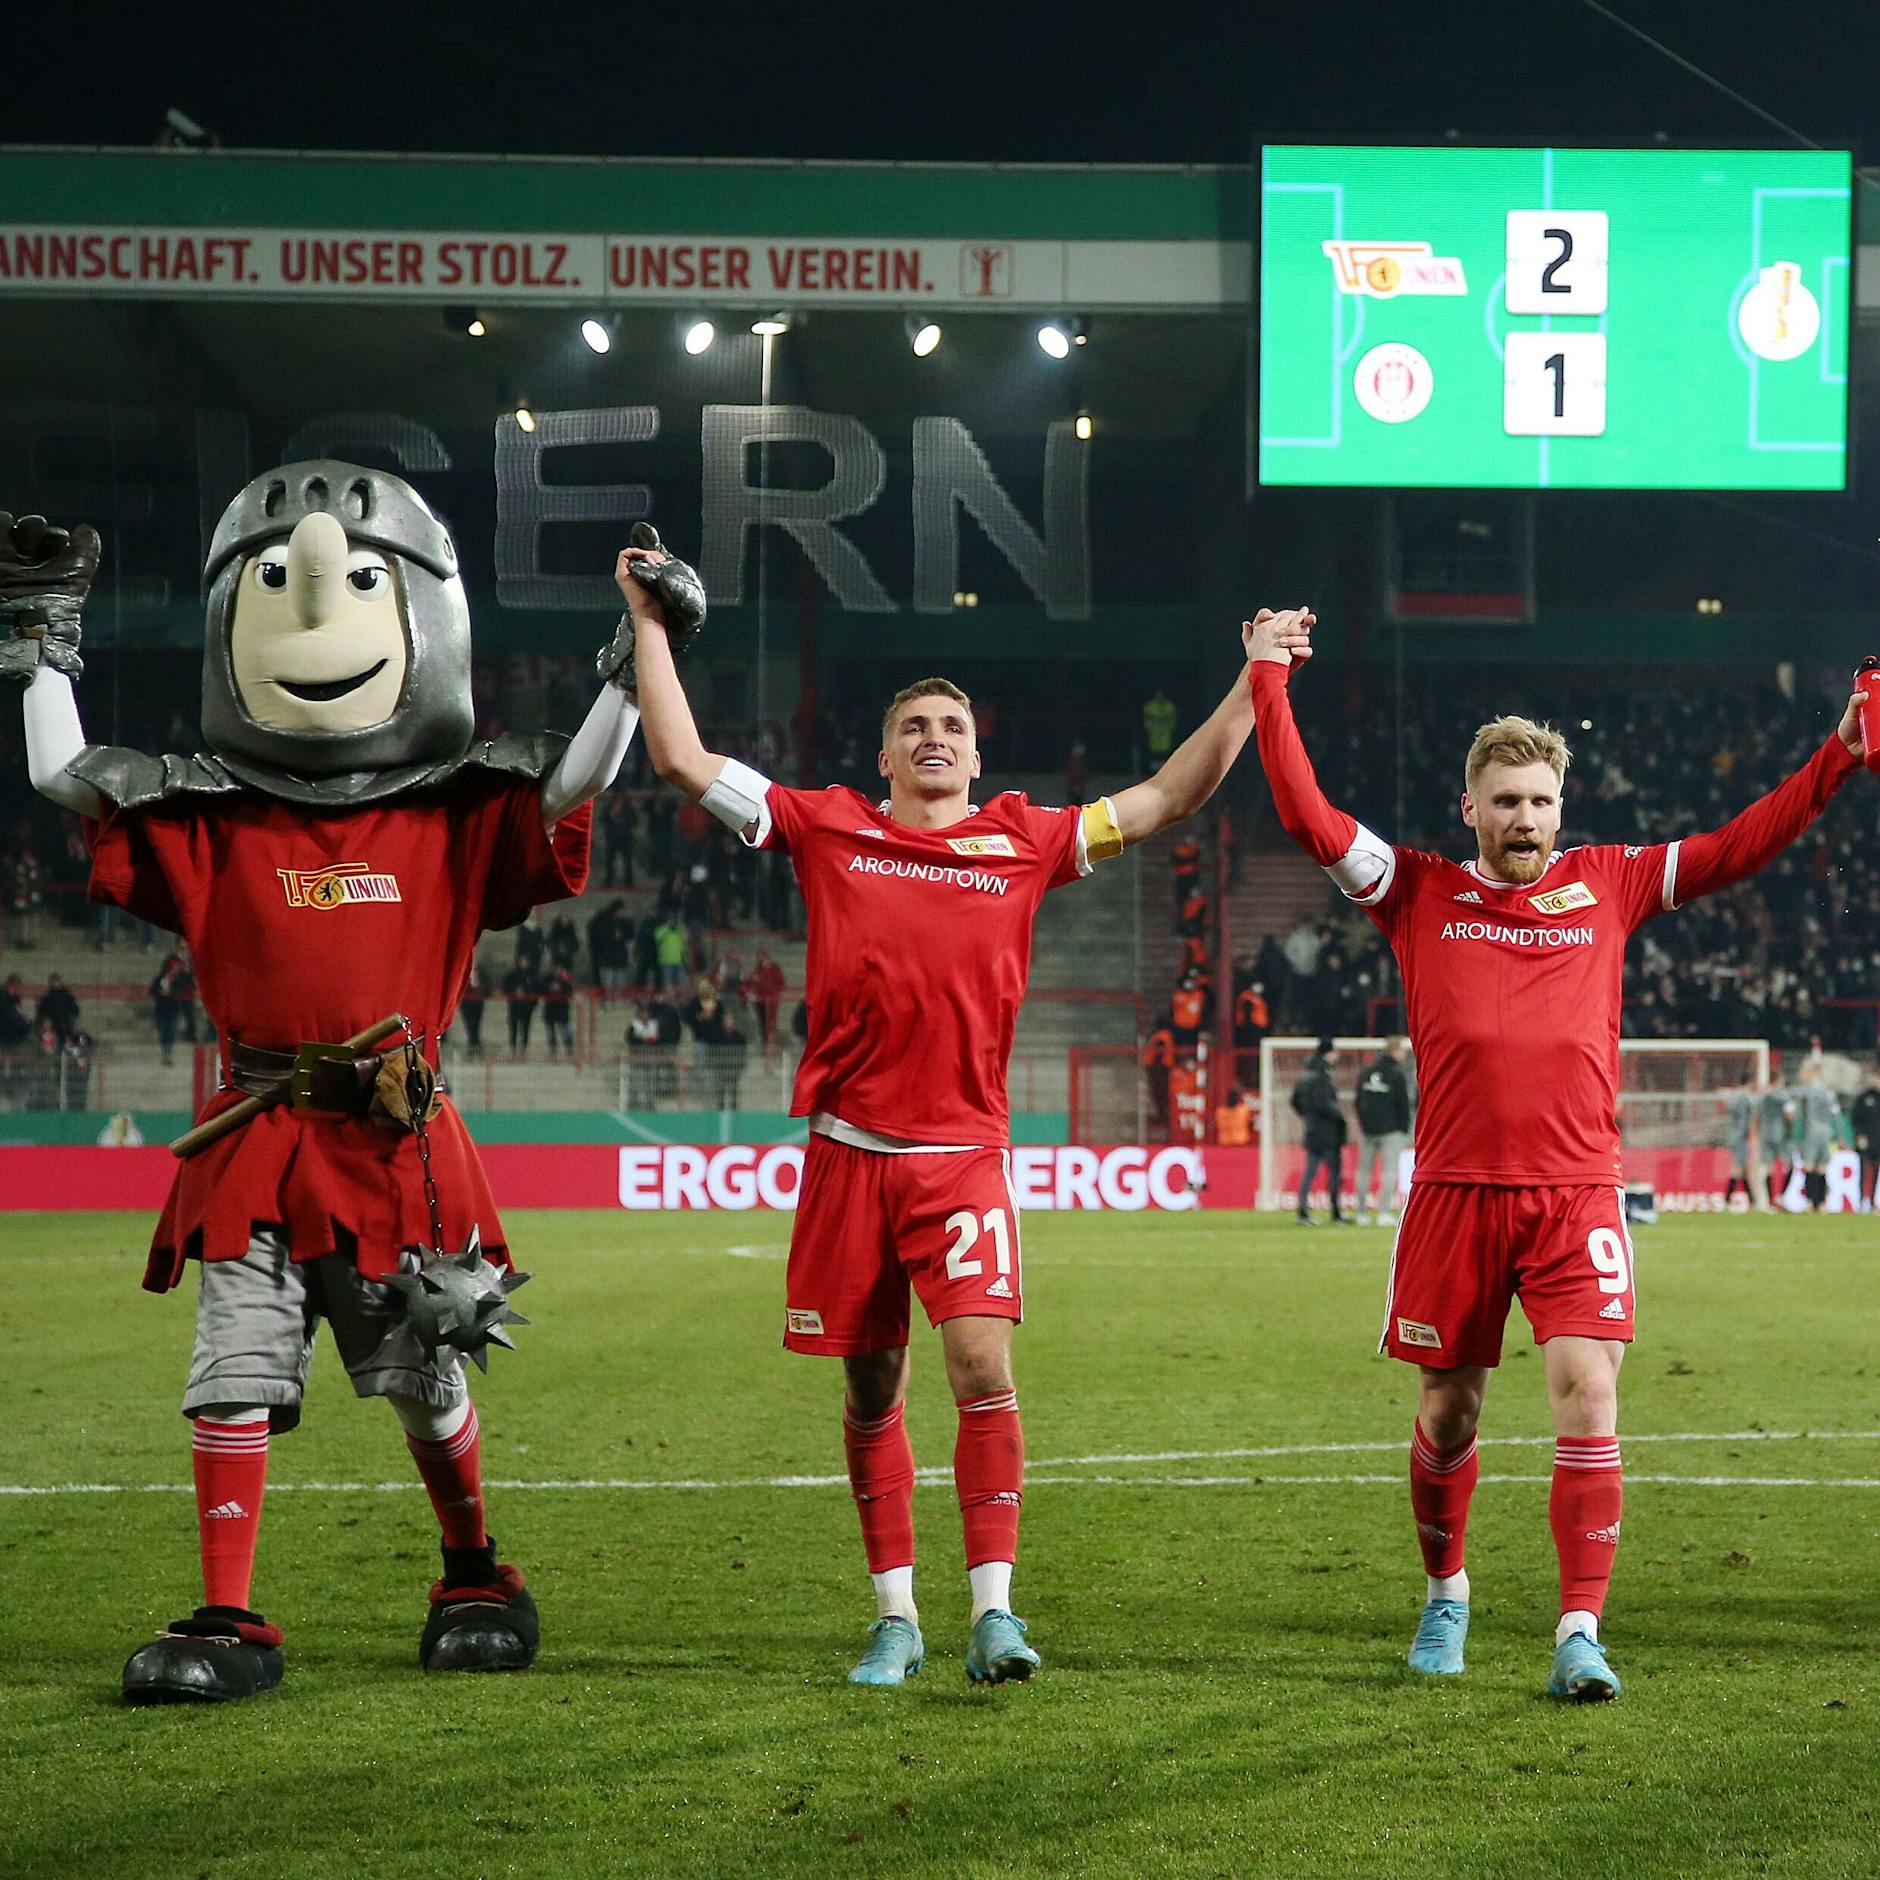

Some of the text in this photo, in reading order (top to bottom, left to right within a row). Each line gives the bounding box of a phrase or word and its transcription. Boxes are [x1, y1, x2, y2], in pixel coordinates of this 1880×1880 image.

[280, 239, 424, 284] UNSER
[437, 243, 581, 287] STOLZ.
[609, 245, 751, 288] UNSER
[766, 246, 934, 292] VEREIN.
[1542, 229, 1573, 293] 2
[1544, 353, 1564, 417] 1
[345, 877, 398, 899] UNION
[849, 855, 1008, 896] AROUNDTOWN
[1440, 921, 1593, 947] AROUNDTOWN
[618, 1145, 805, 1210] ERGO
[1012, 1146, 1203, 1210] ERGO
[945, 1207, 1011, 1280] 21
[1587, 1227, 1629, 1294] 9
[985, 1287, 1014, 1299] adidas
[1599, 1309, 1626, 1321] adidas
